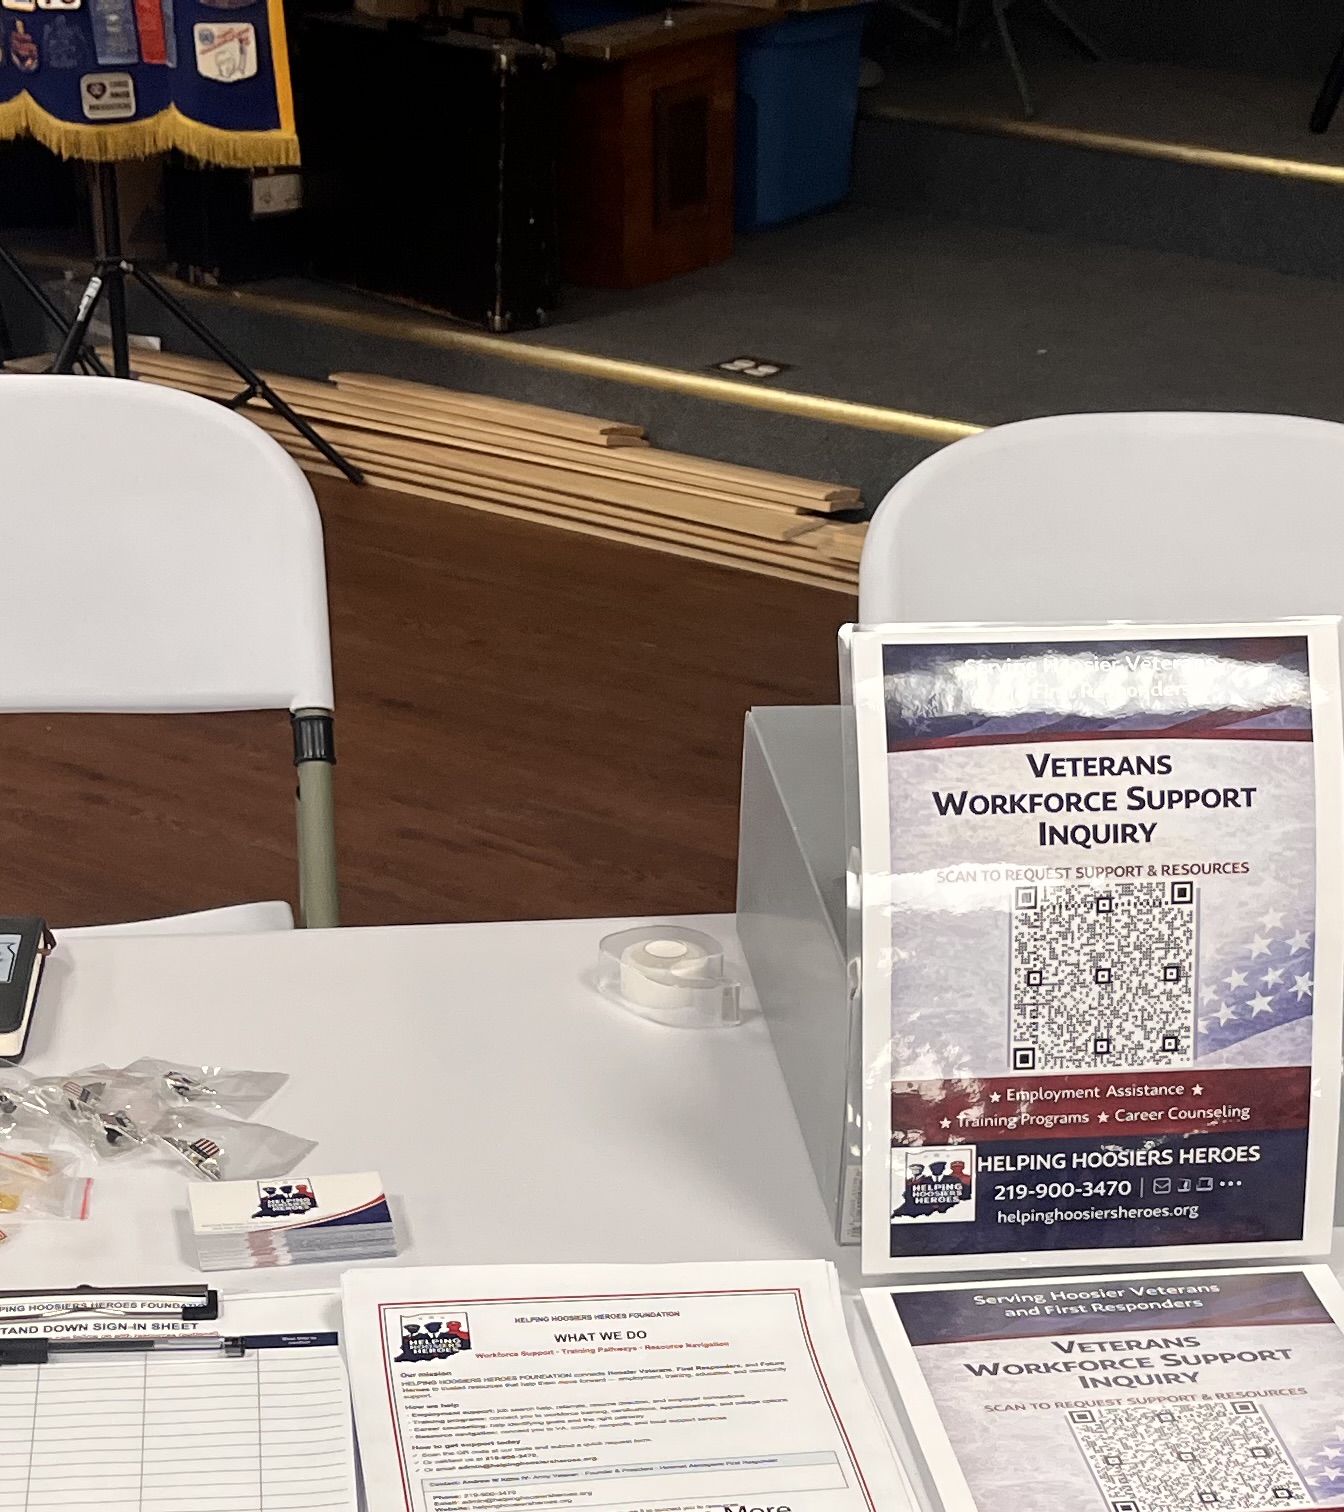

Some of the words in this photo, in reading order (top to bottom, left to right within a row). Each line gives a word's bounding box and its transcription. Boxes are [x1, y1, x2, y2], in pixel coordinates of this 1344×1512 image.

[1026, 753, 1172, 778] VETERANS
[932, 790, 1116, 815] WORKFORCE
[1127, 786, 1257, 810] SUPPORT
[1039, 822, 1158, 848] INQUIRY
[937, 869, 977, 883] SCAN
[981, 868, 1001, 881] TO
[1006, 866, 1071, 882] REQUEST
[1076, 864, 1144, 879] SUPPORT
[1147, 864, 1157, 877] &
[1161, 861, 1249, 876] RESOURCES
[1006, 1086, 1101, 1105] Employment
[1106, 1082, 1185, 1099] Assistance
[957, 1114, 1017, 1130] Training
[1021, 1111, 1089, 1128] Programs
[1115, 1107, 1164, 1123] Career
[1168, 1105, 1250, 1121] Counseling
[978, 1152, 1066, 1172] HELPING
[1072, 1149, 1173, 1169] HOOSIERS
[1179, 1146, 1260, 1165] HEROES
[913, 1183, 962, 1191] HELPING
[994, 1180, 1132, 1201] 219-900-3470
[997, 1203, 1199, 1226] helpinghoosiersheroes.org
[973, 1291, 1043, 1308] Serving
[1049, 1286, 1124, 1303] Hoosier
[1130, 1281, 1220, 1298] Veterans
[91, 1302, 138, 1310] HEROES
[140, 1302, 205, 1310] FOUNDATIO
[1004, 1306, 1038, 1318] and
[1044, 1302, 1083, 1316] First
[1089, 1297, 1204, 1316] Responders
[43, 1324, 88, 1334] DOWN
[93, 1322, 147, 1332] SIGN-IN
[151, 1322, 199, 1331] SHEET
[514, 1316, 549, 1324] HELPING
[552, 1314, 592, 1323] HOOSIERS
[594, 1313, 627, 1321] HEROES
[629, 1311, 680, 1320] FOUNDATION
[554, 1332, 597, 1343] WHAT
[601, 1331, 623, 1342] WE
[626, 1330, 647, 1340] DO
[1051, 1337, 1201, 1356] VETERANS
[963, 1356, 1155, 1378] WORKFORCE
[1162, 1348, 1293, 1369] SUPPORT
[1078, 1371, 1199, 1390] INQUIRY
[984, 1403, 1024, 1414] SCAN
[1028, 1402, 1051, 1411] TO
[1055, 1398, 1122, 1410] REQUEST
[1127, 1394, 1197, 1406] SUPPORT
[1201, 1393, 1212, 1402] &
[1215, 1388, 1308, 1401] RESOURCES
